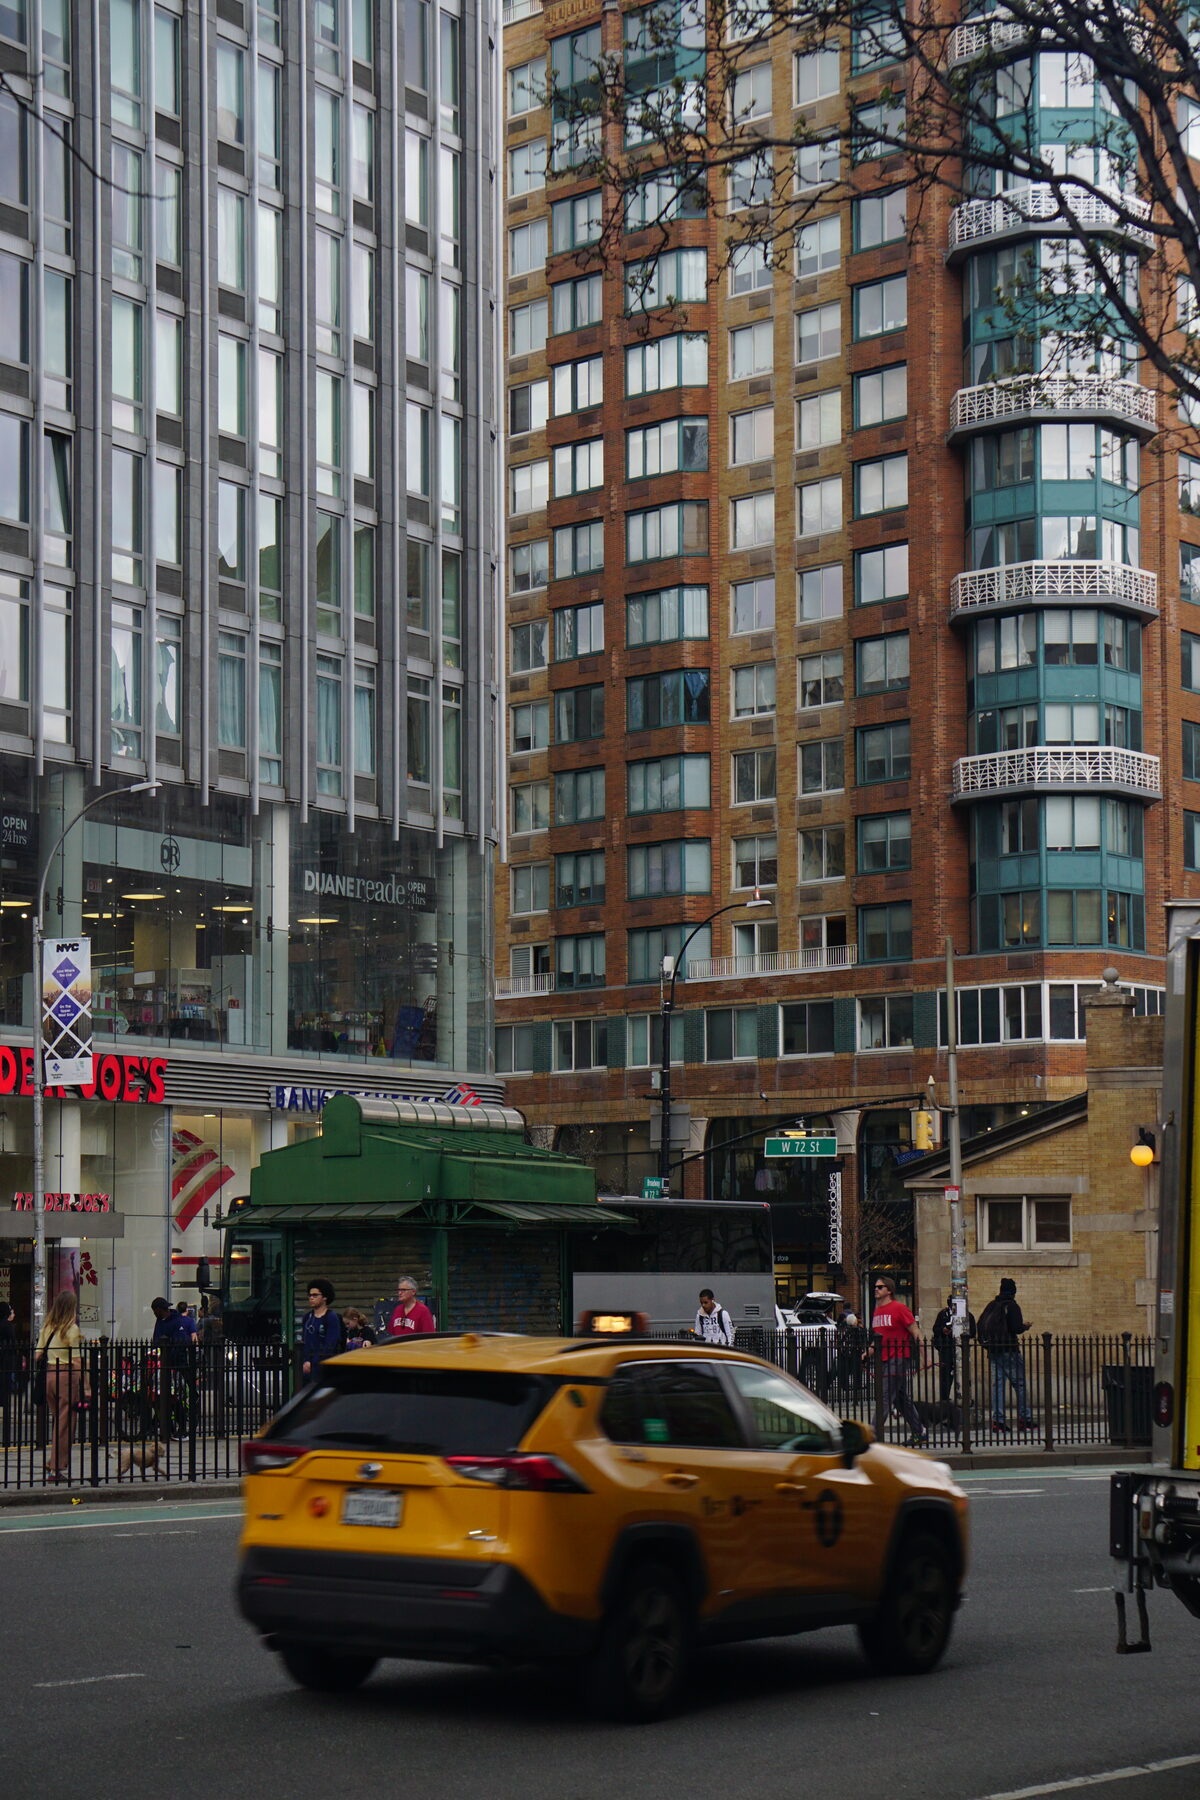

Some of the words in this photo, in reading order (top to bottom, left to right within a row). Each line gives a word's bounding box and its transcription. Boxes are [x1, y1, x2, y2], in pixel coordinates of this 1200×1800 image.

[2, 816, 27, 831] OPEN
[2, 829, 27, 845] 24hrs
[408, 881, 426, 894] OPEN
[56, 943, 80, 953] NYC
[0, 1045, 66, 1098] DE
[276, 1086, 327, 1113] BANK
[781, 1141, 791, 1153] W
[795, 1141, 806, 1152] 72
[809, 1141, 820, 1152] St
[646, 1178, 661, 1188] Broadway
[649, 1190, 655, 1200] 72
[14, 1192, 71, 1211] TRDER
[75, 1193, 110, 1213] JOE'S
